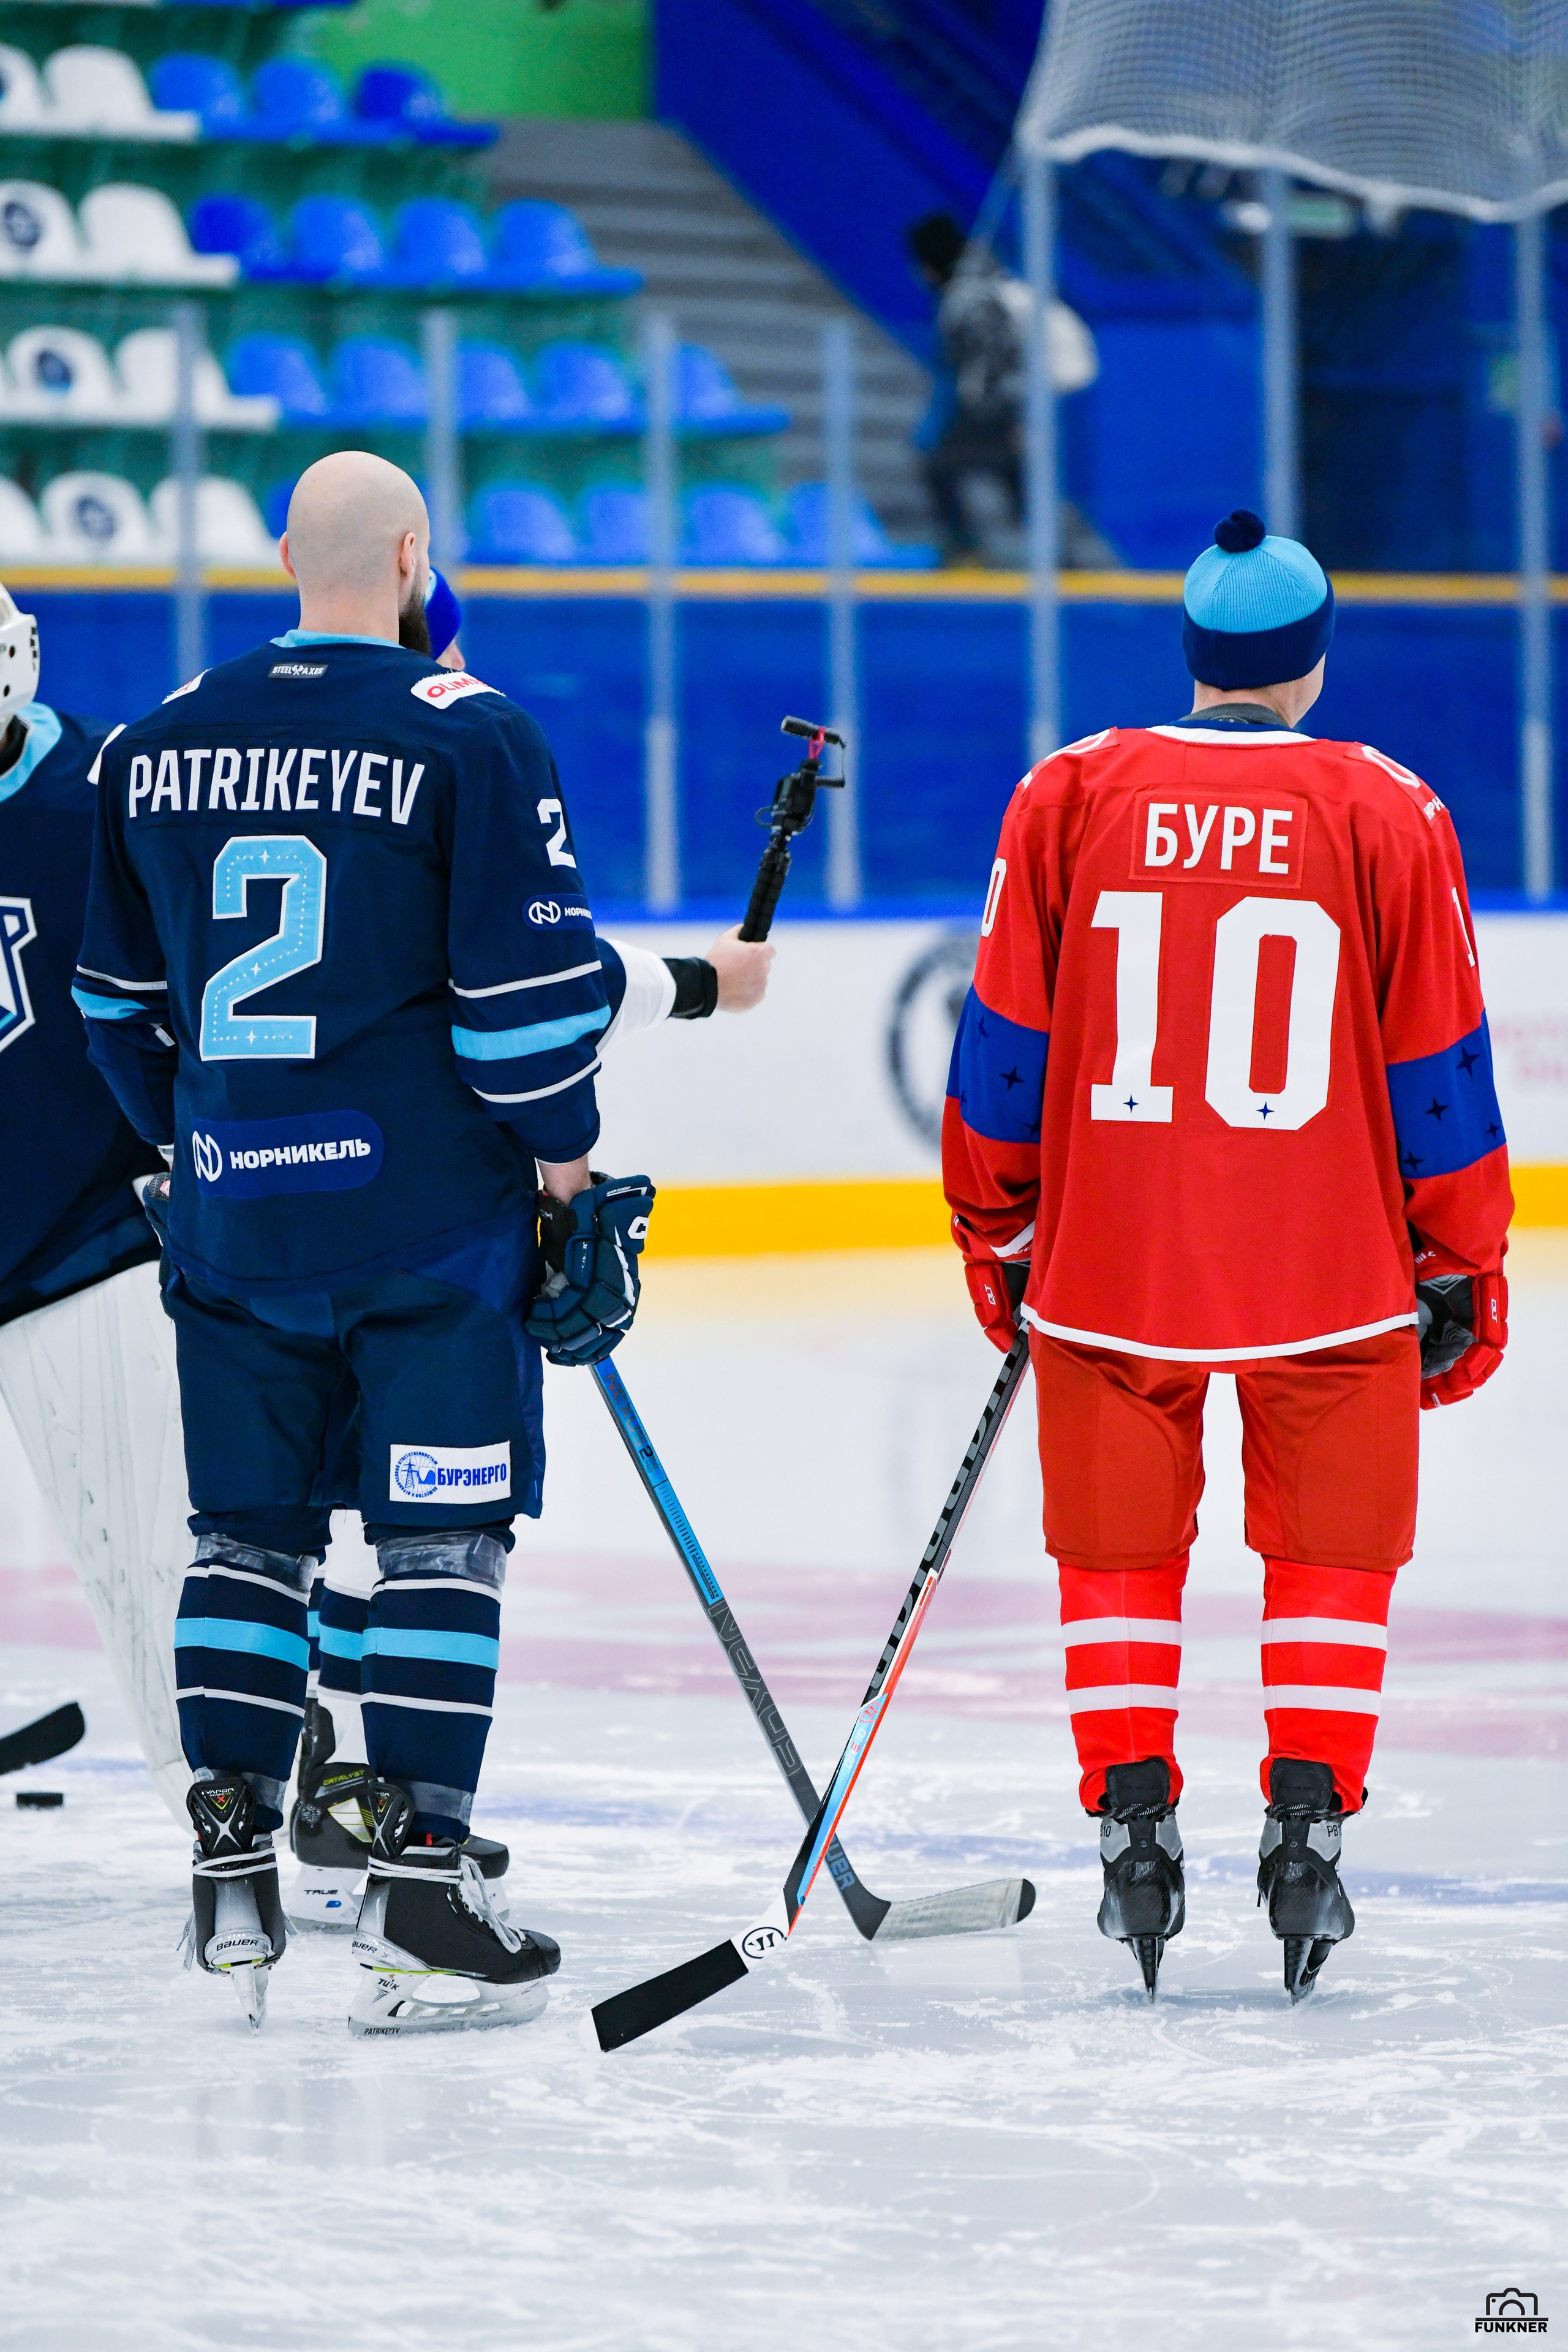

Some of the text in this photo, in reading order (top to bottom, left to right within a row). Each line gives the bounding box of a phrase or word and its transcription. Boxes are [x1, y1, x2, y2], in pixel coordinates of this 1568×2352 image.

[272, 666, 324, 676] STEEL AXES
[129, 748, 424, 825] PATRIKEYEV
[537, 799, 577, 869] 2
[1144, 802, 1293, 875] БУРЕ
[199, 835, 327, 1062] 2
[1090, 891, 1341, 1131] 10
[230, 1139, 371, 1169] НОРНИКЕЛЬ
[437, 1463, 507, 1487] БУРЭНЕРГО
[708, 1599, 802, 1777] NEXUS
